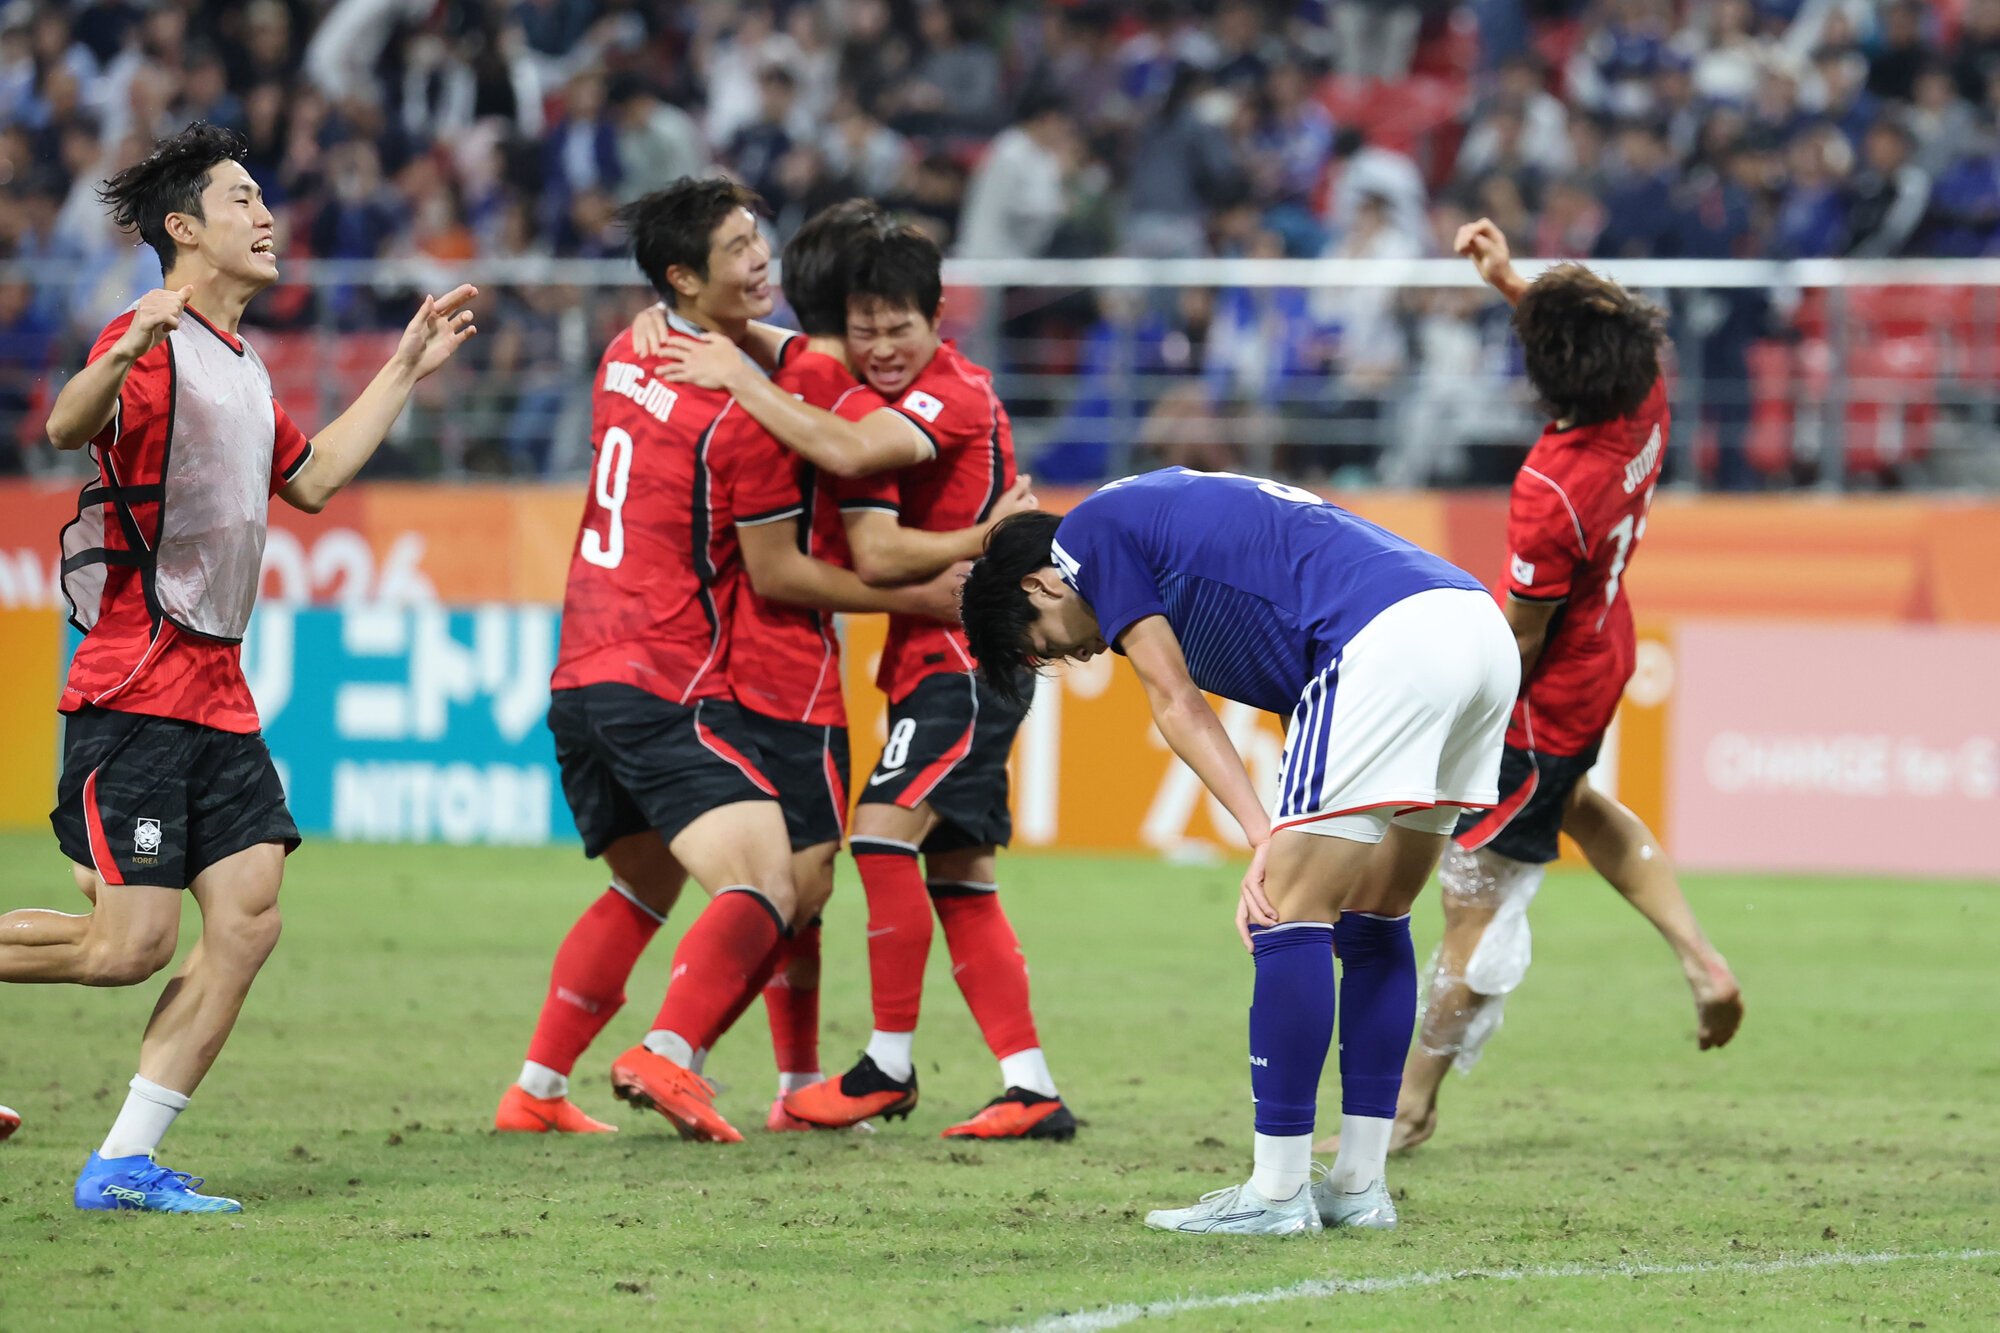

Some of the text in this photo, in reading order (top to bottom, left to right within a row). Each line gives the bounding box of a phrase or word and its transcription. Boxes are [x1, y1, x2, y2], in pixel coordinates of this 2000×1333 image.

[580, 426, 634, 570] 9
[258, 525, 442, 606] 026
[882, 717, 917, 769] 8
[333, 760, 550, 844] NITORI
[132, 855, 159, 865] KOREA
